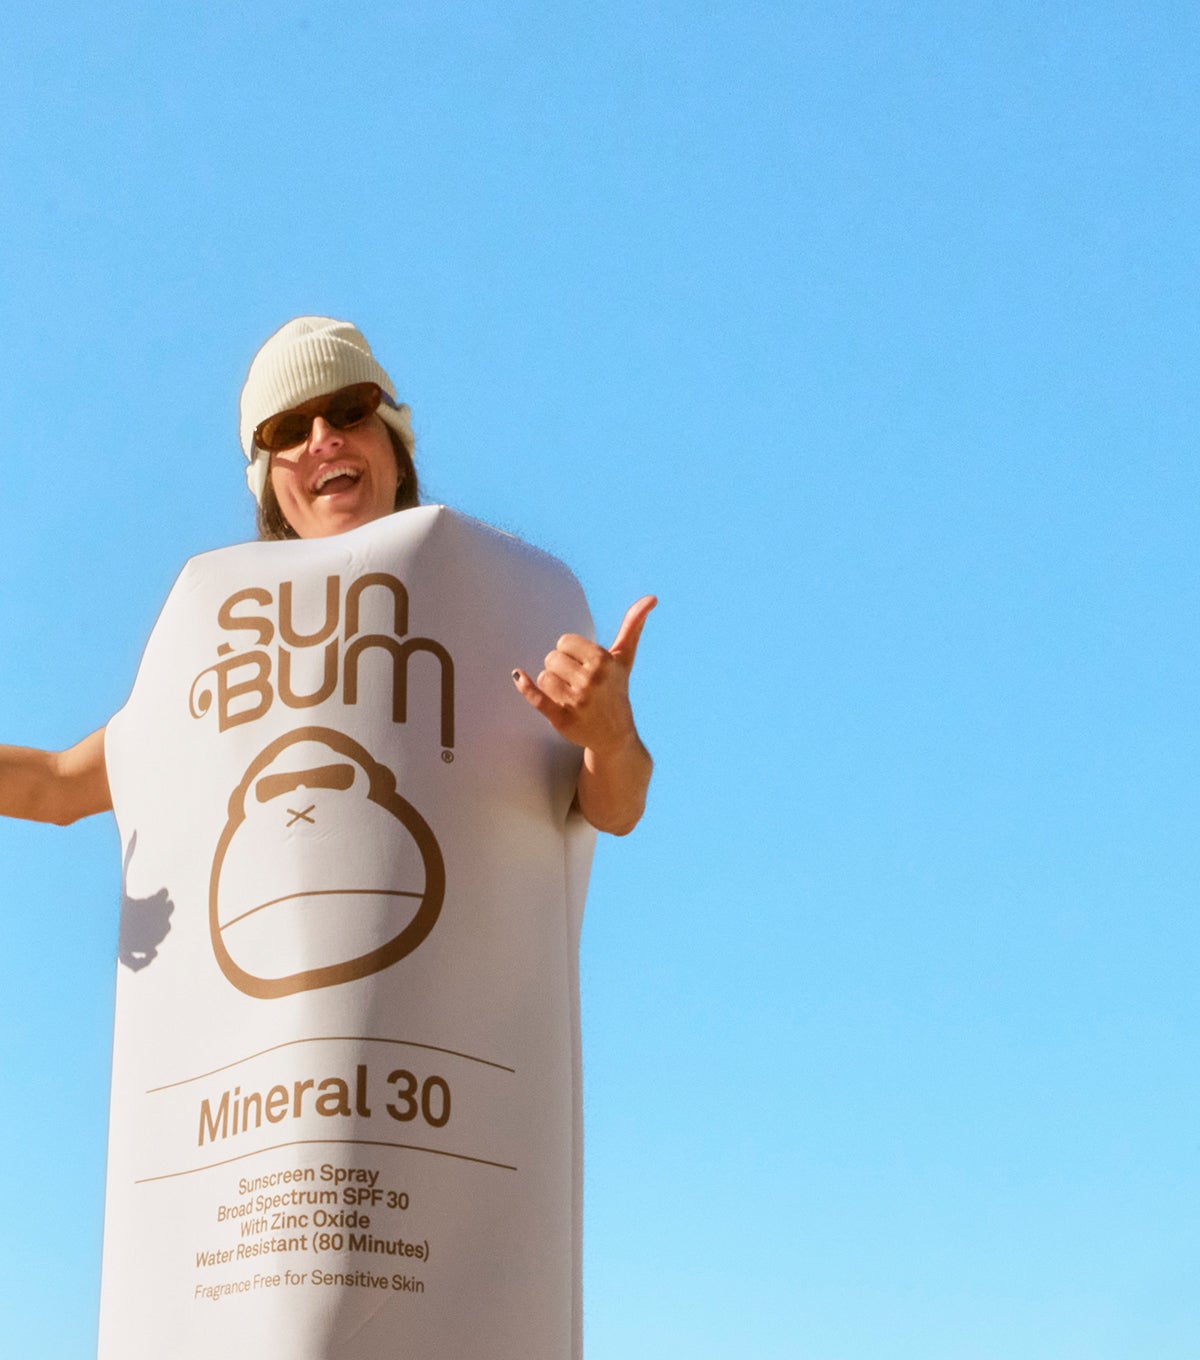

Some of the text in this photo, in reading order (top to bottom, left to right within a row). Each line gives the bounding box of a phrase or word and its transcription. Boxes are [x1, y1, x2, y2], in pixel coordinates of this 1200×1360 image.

[198, 1065, 451, 1146] Mineral 30
[239, 1164, 380, 1195] Sunscreen Spray
[217, 1187, 409, 1222] Broad Spectrum SPF 30
[240, 1210, 370, 1238] With Zinc Oxide
[196, 1231, 429, 1268] Water Resistant (80 Minutes)
[194, 1269, 425, 1301] Fragrance Free for Sensitive Skin
